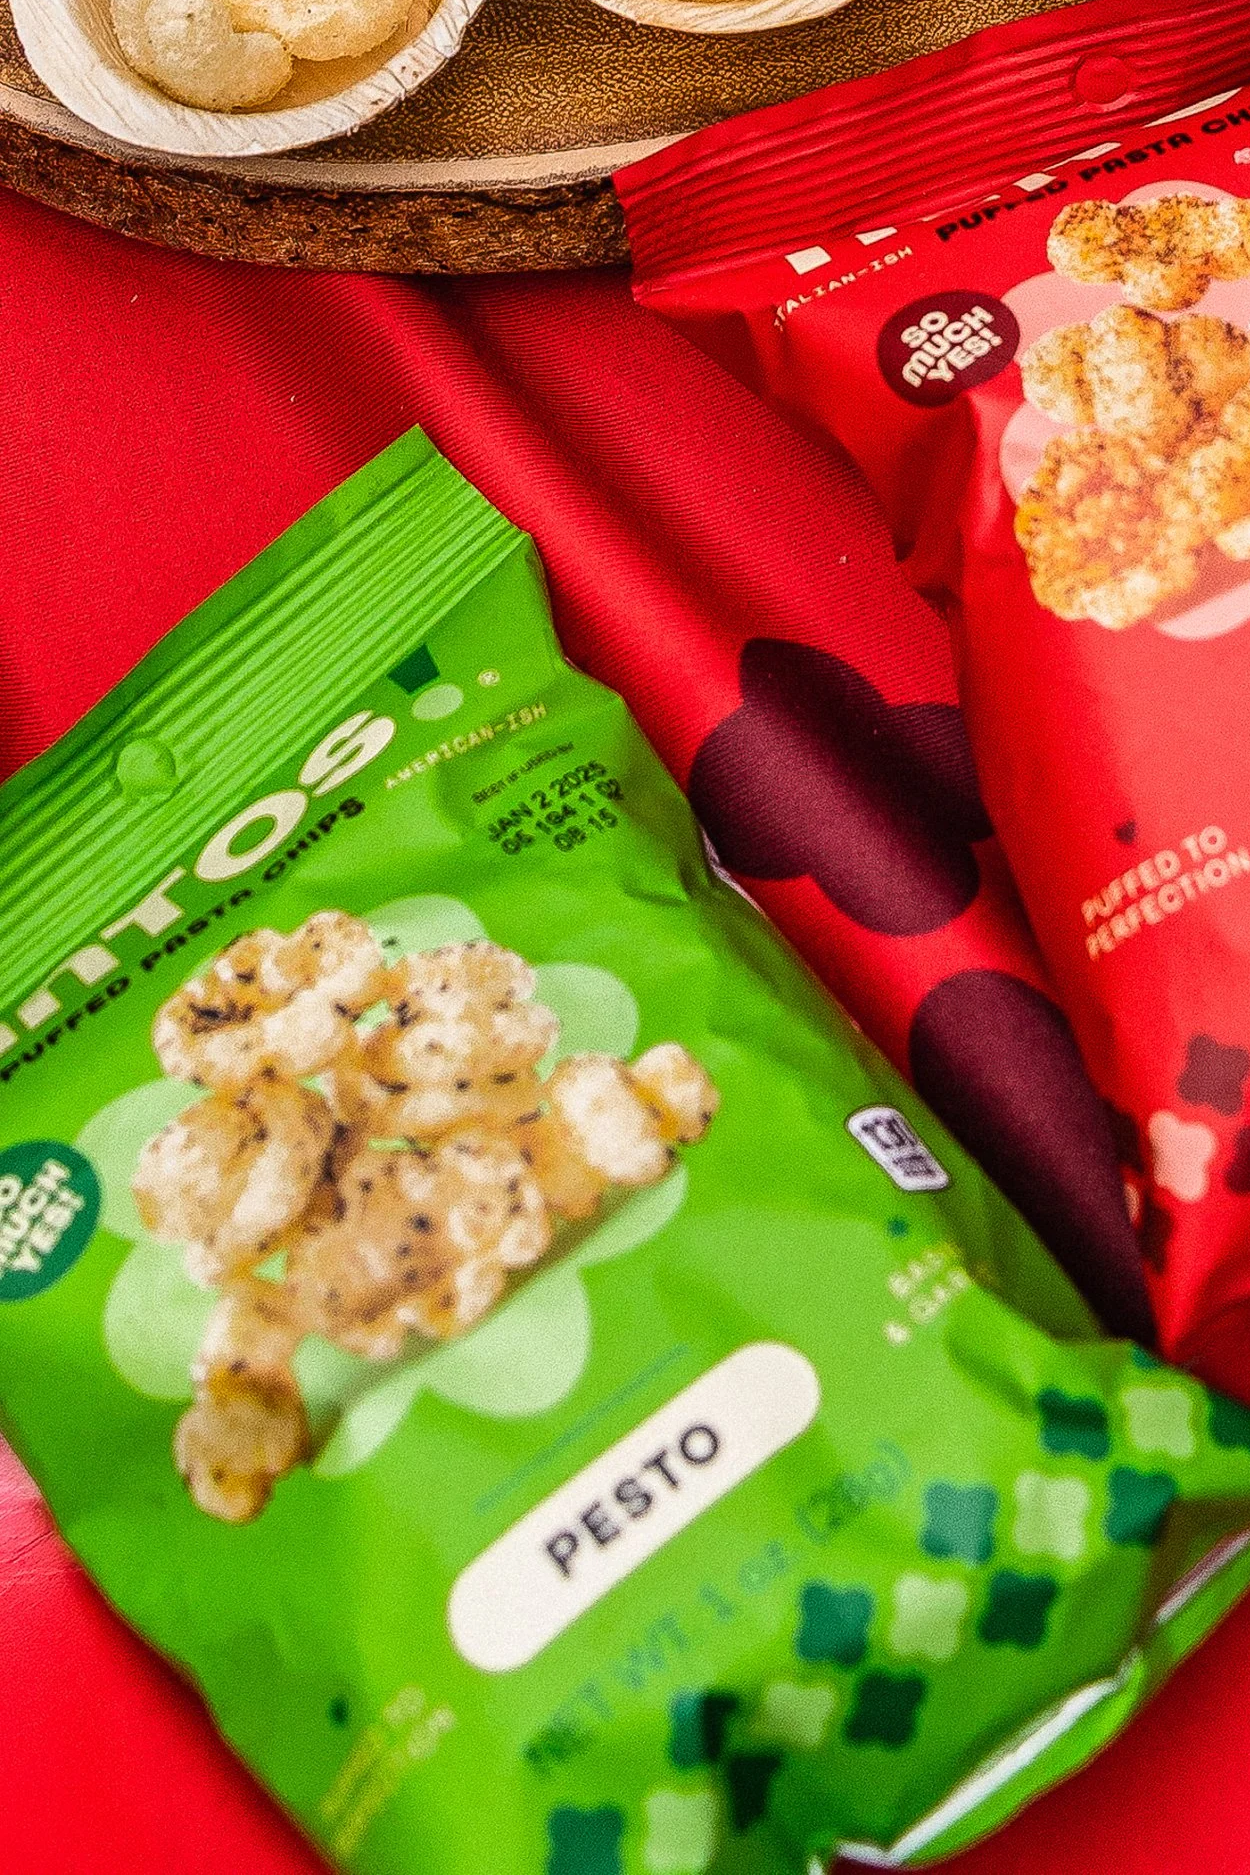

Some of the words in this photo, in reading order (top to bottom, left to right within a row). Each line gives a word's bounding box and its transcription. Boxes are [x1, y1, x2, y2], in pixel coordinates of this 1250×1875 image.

[1080, 132, 1193, 182] PASTA
[901, 310, 949, 349] SO
[901, 305, 995, 388] MUCH
[926, 327, 1003, 383] YES!
[384, 702, 547, 790] AMERICAN-ISH
[488, 801, 533, 842] JAN
[531, 790, 552, 810] 2
[549, 760, 607, 798] 2025
[578, 792, 597, 807] 1
[1080, 849, 1182, 926] PUFFED
[1181, 824, 1228, 865] TO
[0, 975, 131, 1081] PUFFED
[141, 888, 253, 971] PASTA
[263, 797, 365, 882] CHIPS
[545, 1423, 719, 1579] PESTO
